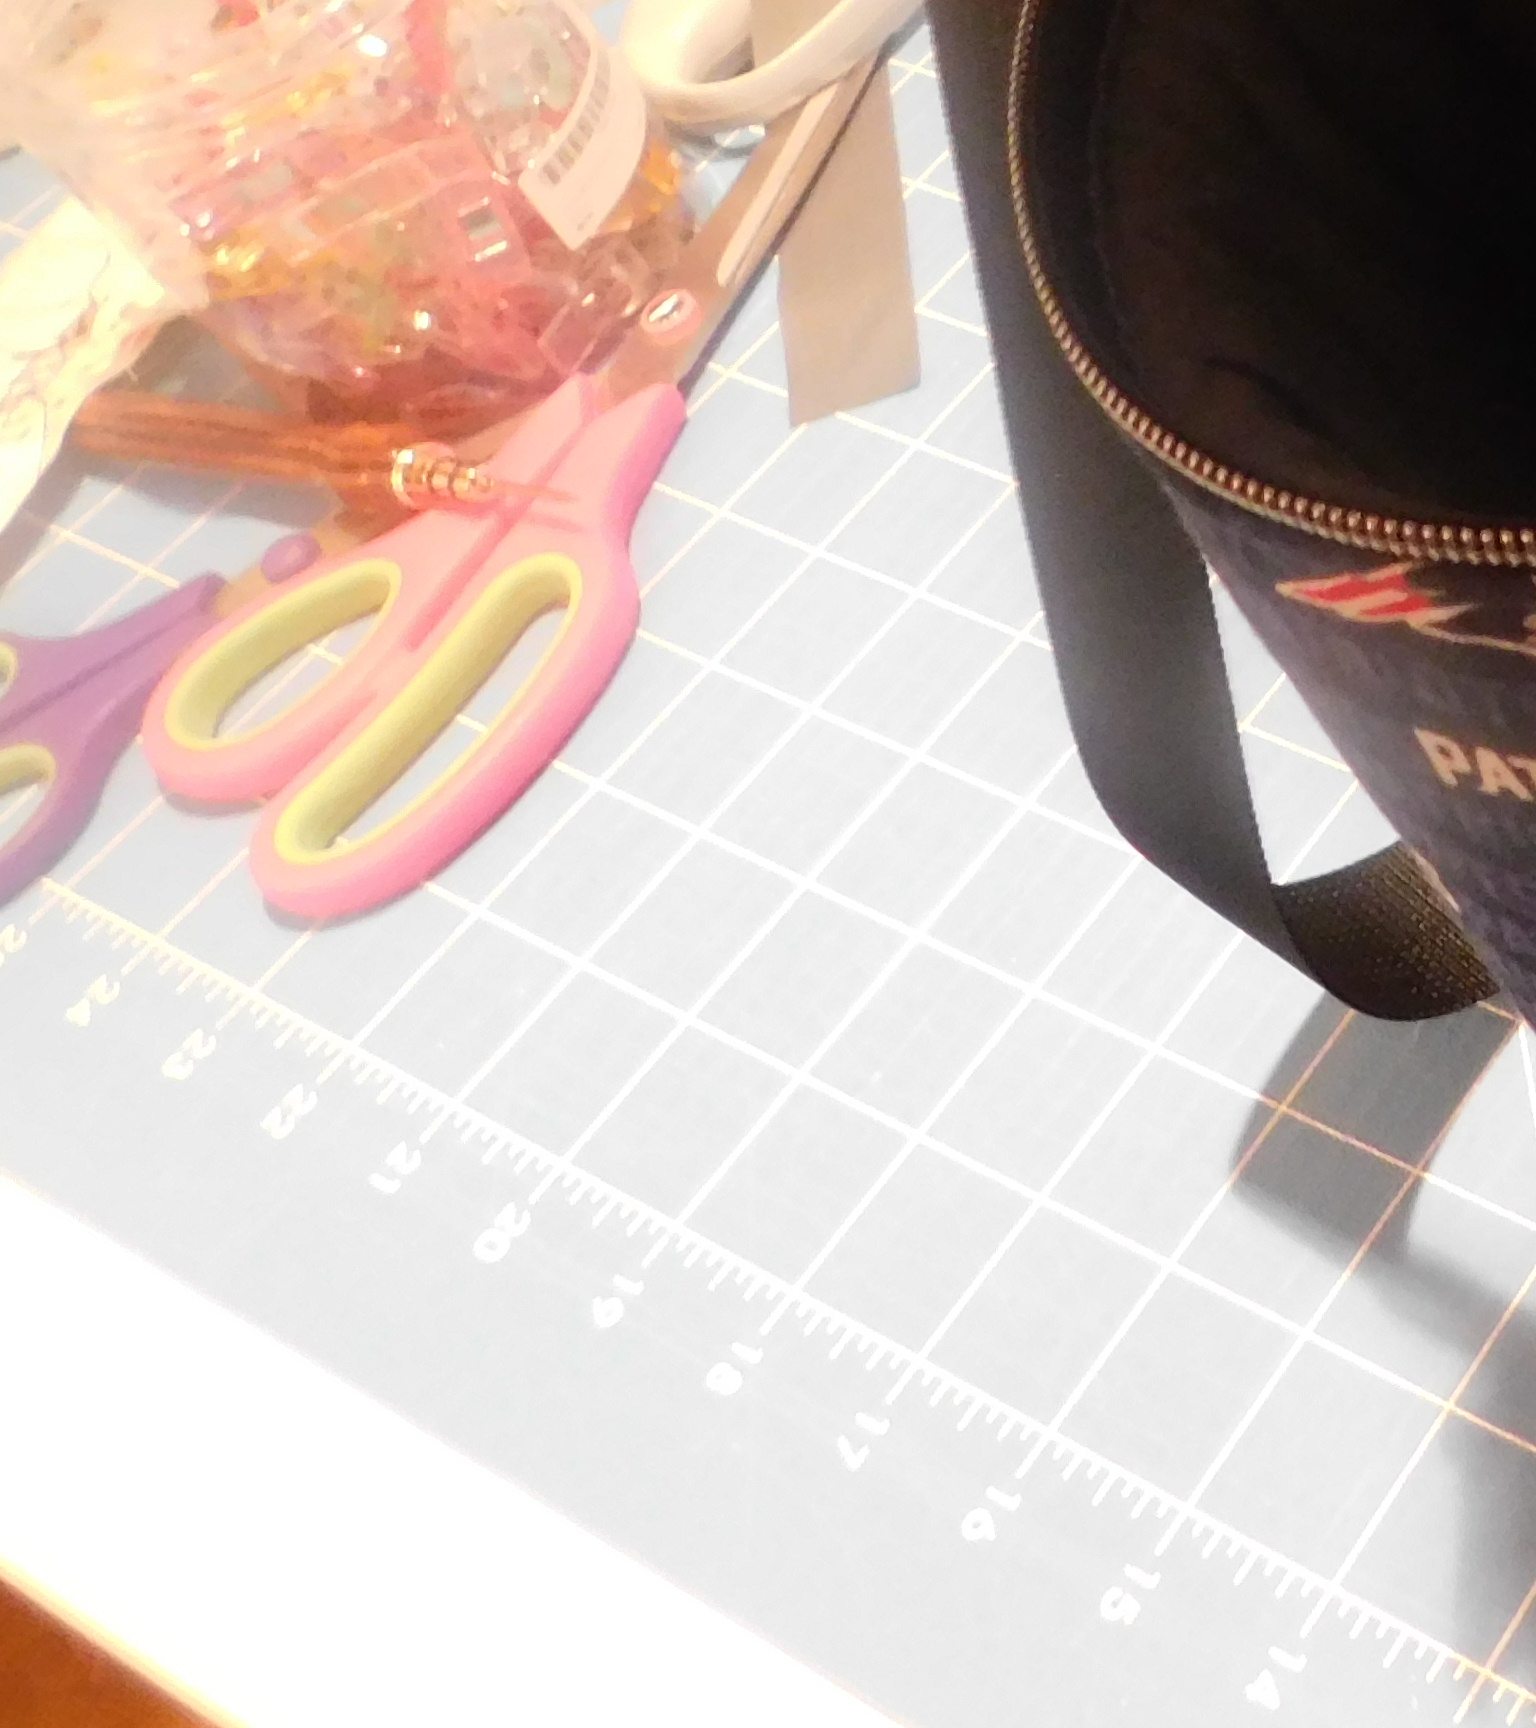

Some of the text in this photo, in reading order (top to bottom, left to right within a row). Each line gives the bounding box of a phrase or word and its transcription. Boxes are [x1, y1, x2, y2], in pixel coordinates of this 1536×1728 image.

[65, 974, 121, 1027] 24
[161, 1028, 217, 1081] 23
[259, 1082, 319, 1140] 22
[368, 1140, 423, 1195] 21
[472, 1201, 532, 1265] 20
[591, 1273, 645, 1330] 19
[704, 1341, 764, 1396] 18
[837, 1412, 890, 1472] 17
[960, 1485, 1023, 1543] 16
[1099, 1563, 1161, 1625] 15
[1244, 1646, 1307, 1710] 14
